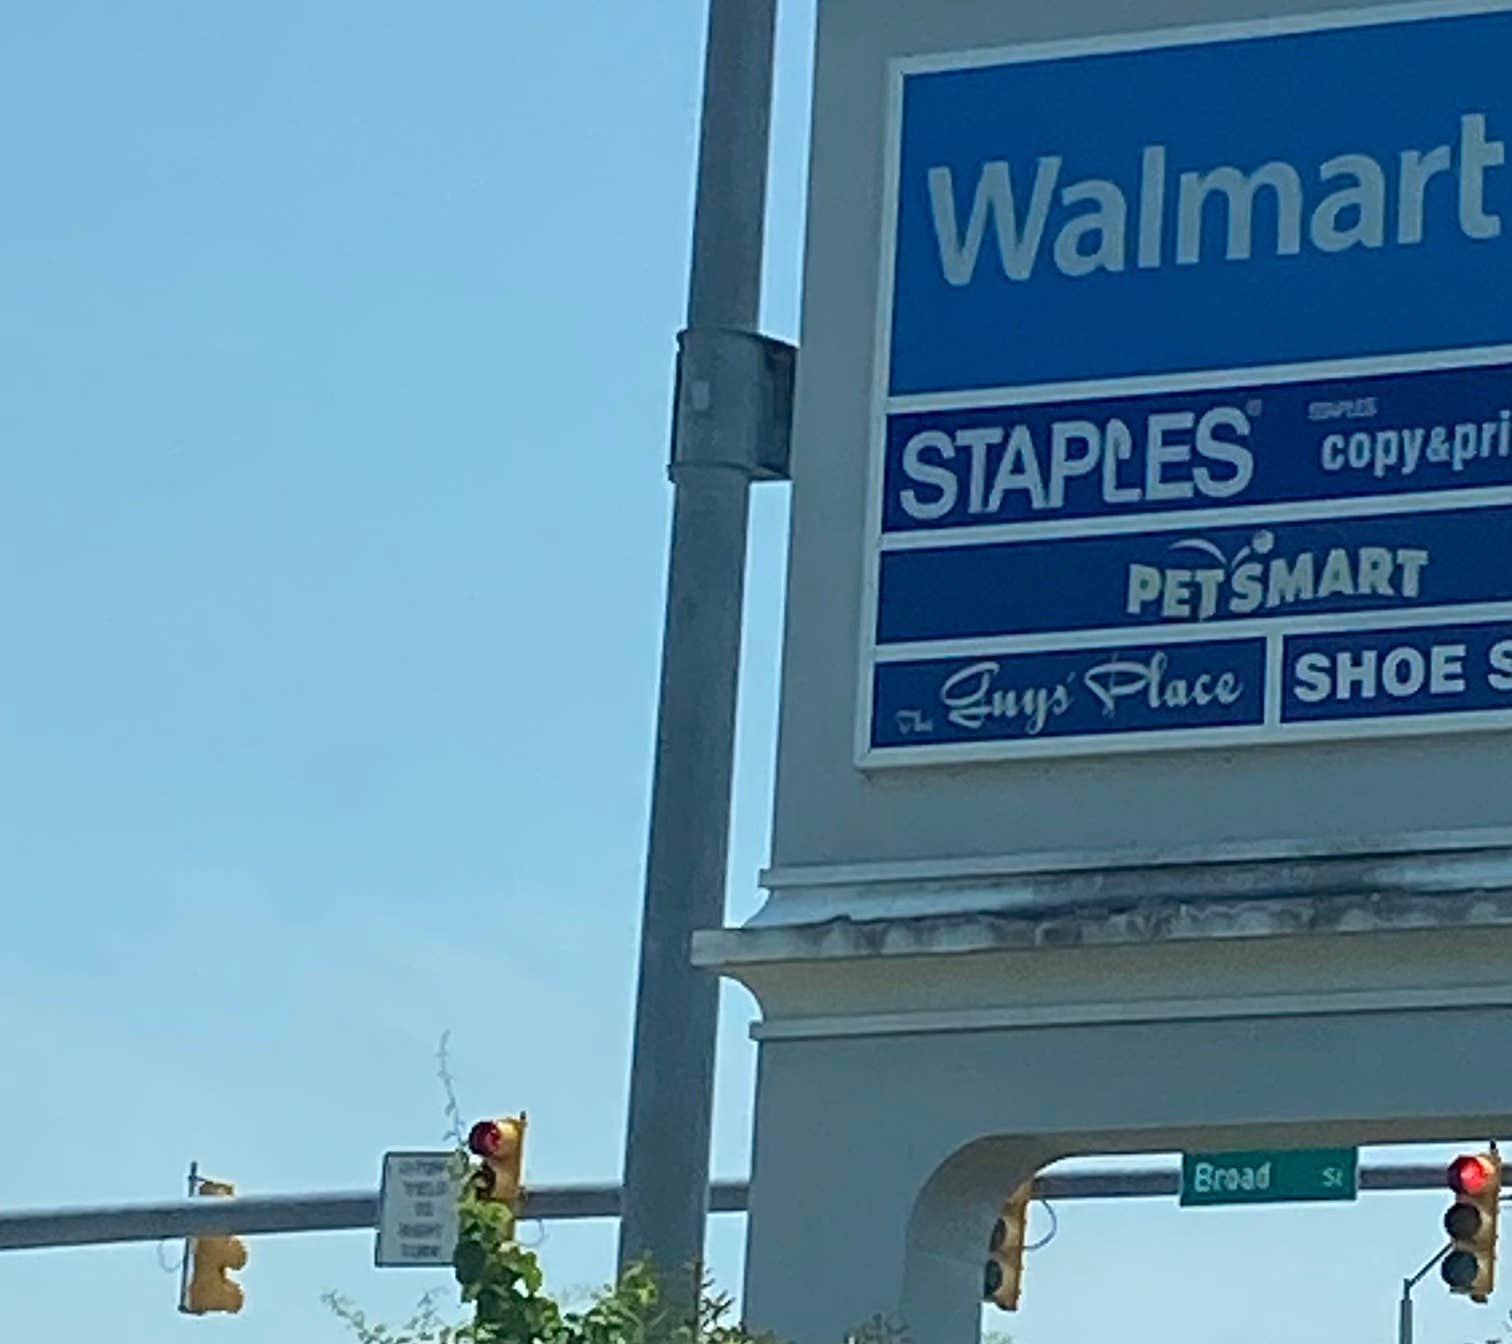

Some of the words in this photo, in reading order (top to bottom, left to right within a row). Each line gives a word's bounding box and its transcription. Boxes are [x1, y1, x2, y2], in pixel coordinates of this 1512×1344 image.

[927, 113, 1506, 288] Walmart
[899, 406, 1255, 520] STAPLES
[1083, 649, 1244, 720] Place
[1293, 642, 1468, 703] SHOE
[1194, 1161, 1272, 1193] Broad
[1321, 1167, 1344, 1187] St
